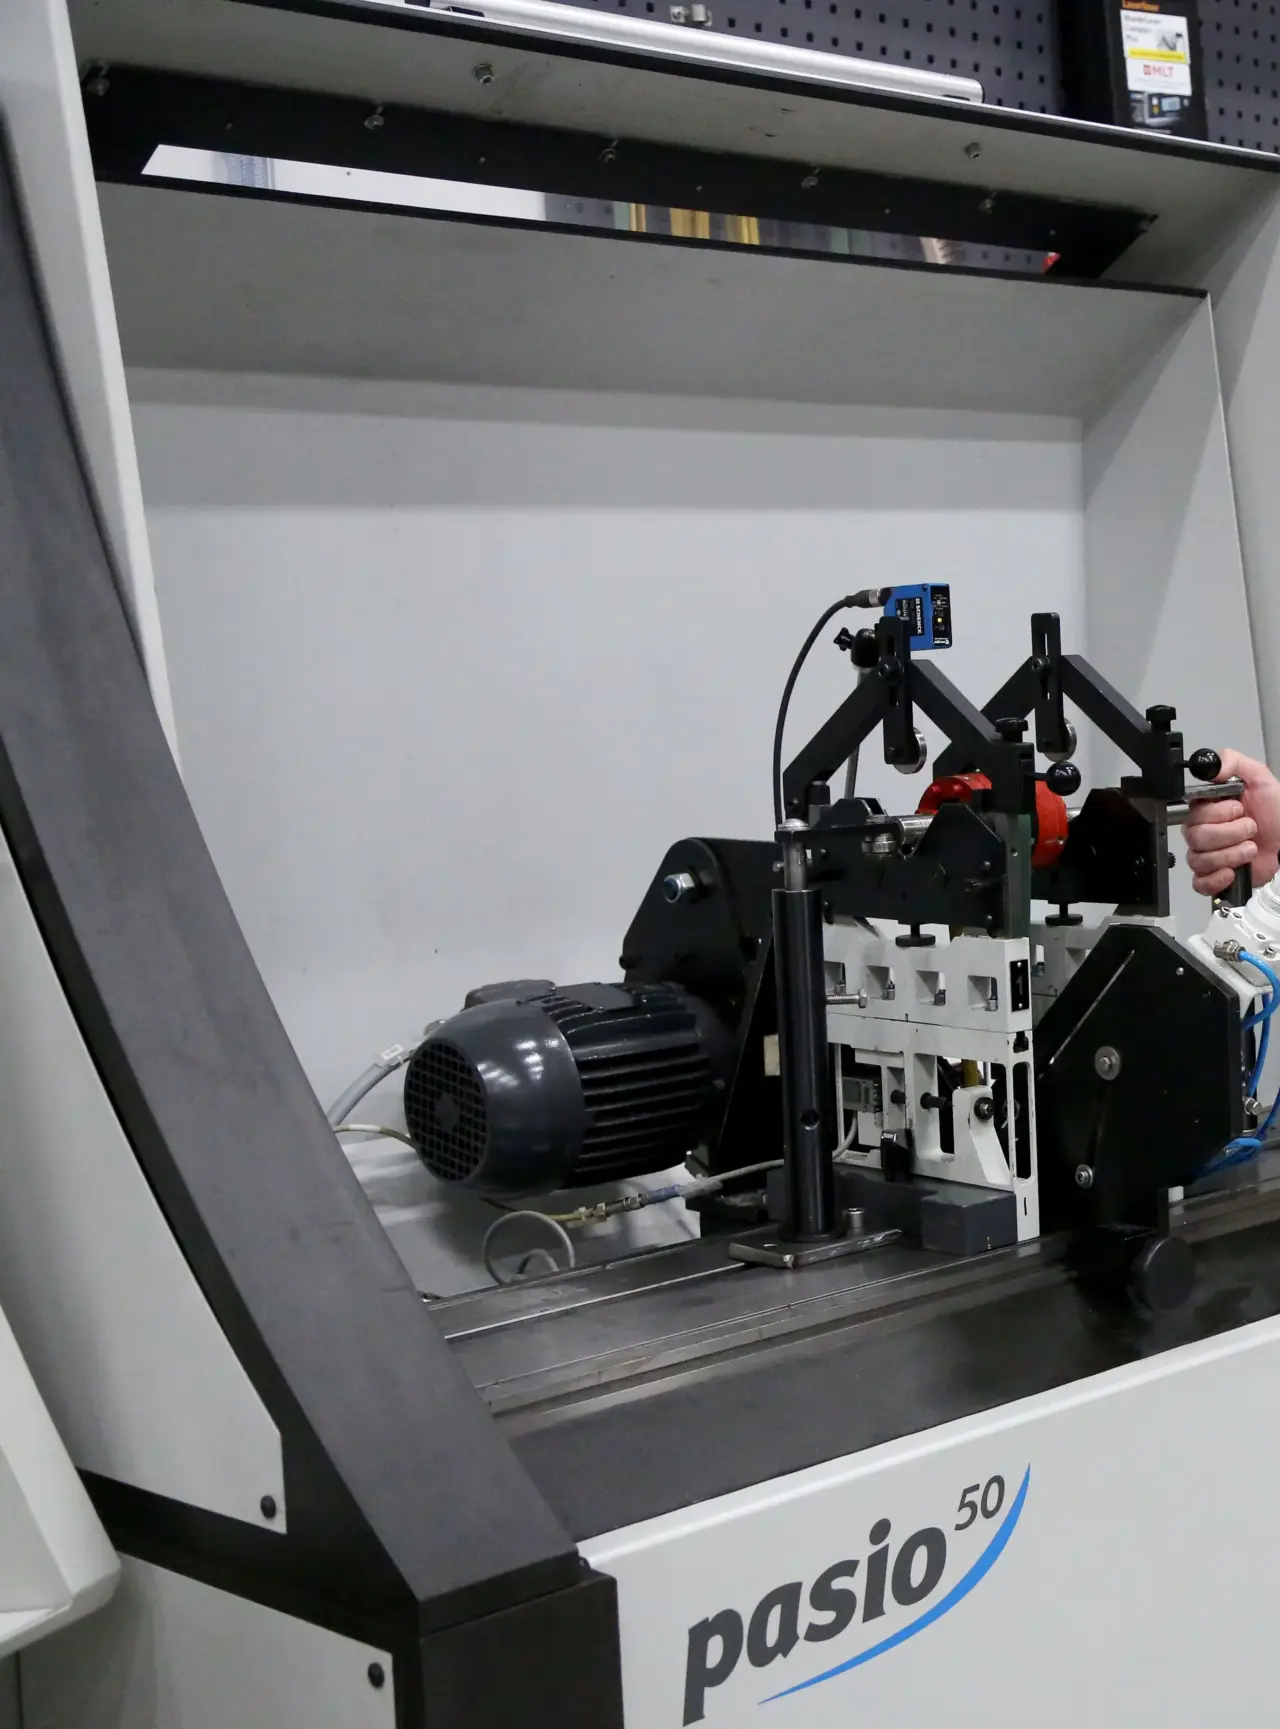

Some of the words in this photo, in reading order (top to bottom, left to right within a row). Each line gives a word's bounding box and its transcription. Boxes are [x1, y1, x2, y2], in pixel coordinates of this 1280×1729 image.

[1152, 66, 1175, 78] MLT
[682, 1517, 948, 1728] pasio
[954, 1474, 1006, 1532] 50
